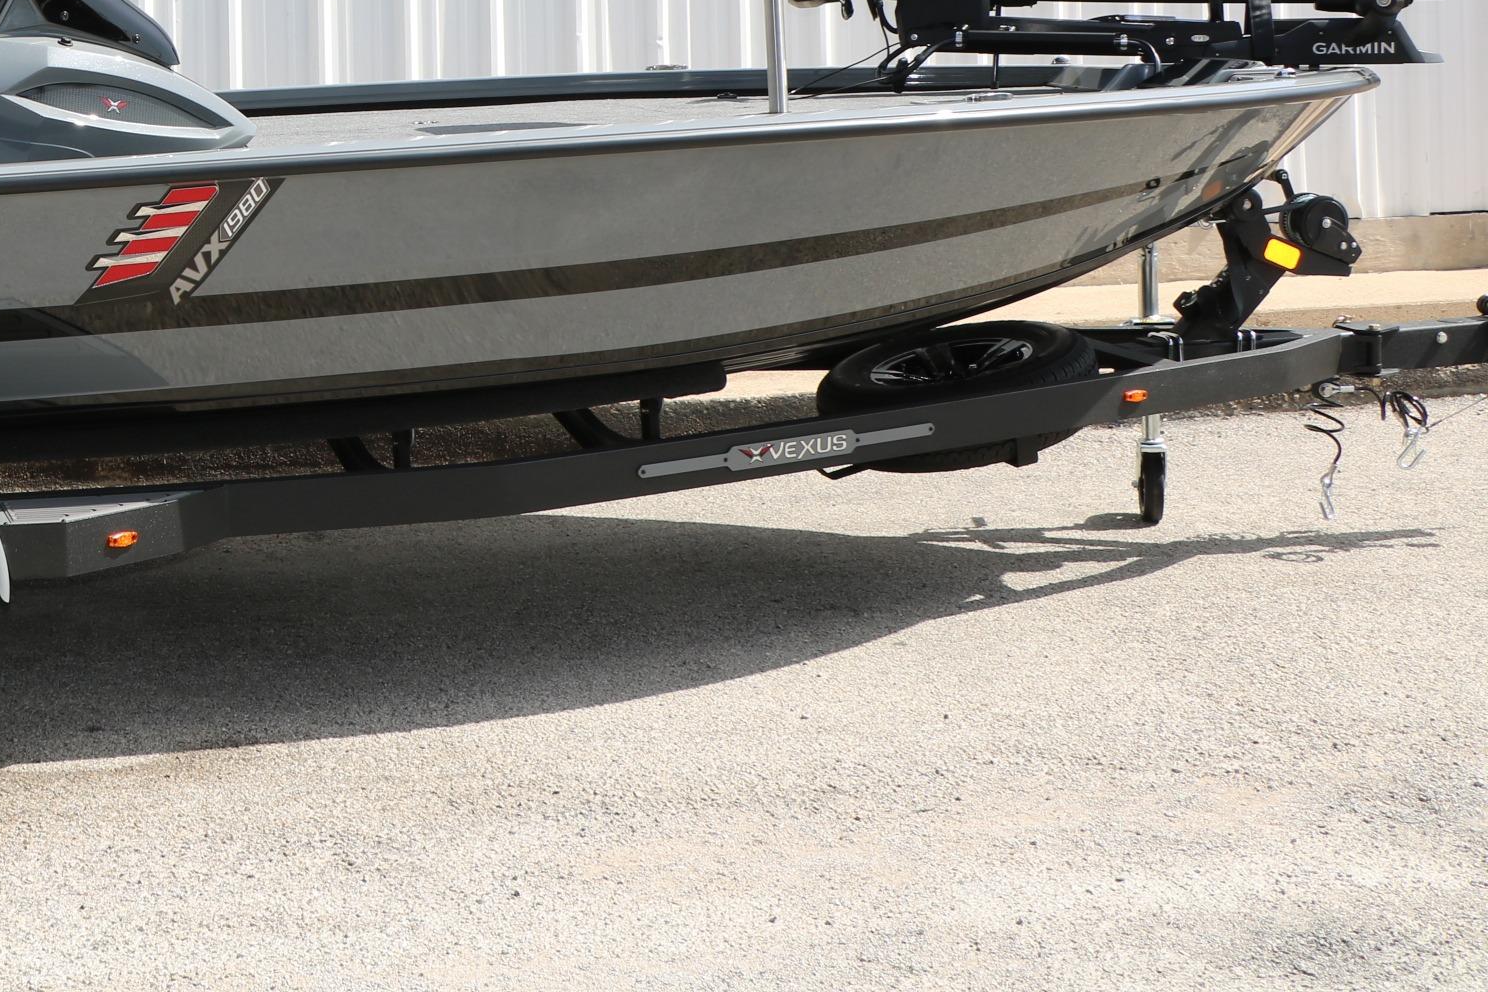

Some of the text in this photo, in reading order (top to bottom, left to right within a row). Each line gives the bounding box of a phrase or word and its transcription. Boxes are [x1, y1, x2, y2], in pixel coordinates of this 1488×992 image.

[1312, 41, 1395, 55] GARMIN
[169, 177, 269, 306] AVX 1980
[769, 434, 848, 460] VEXUS
